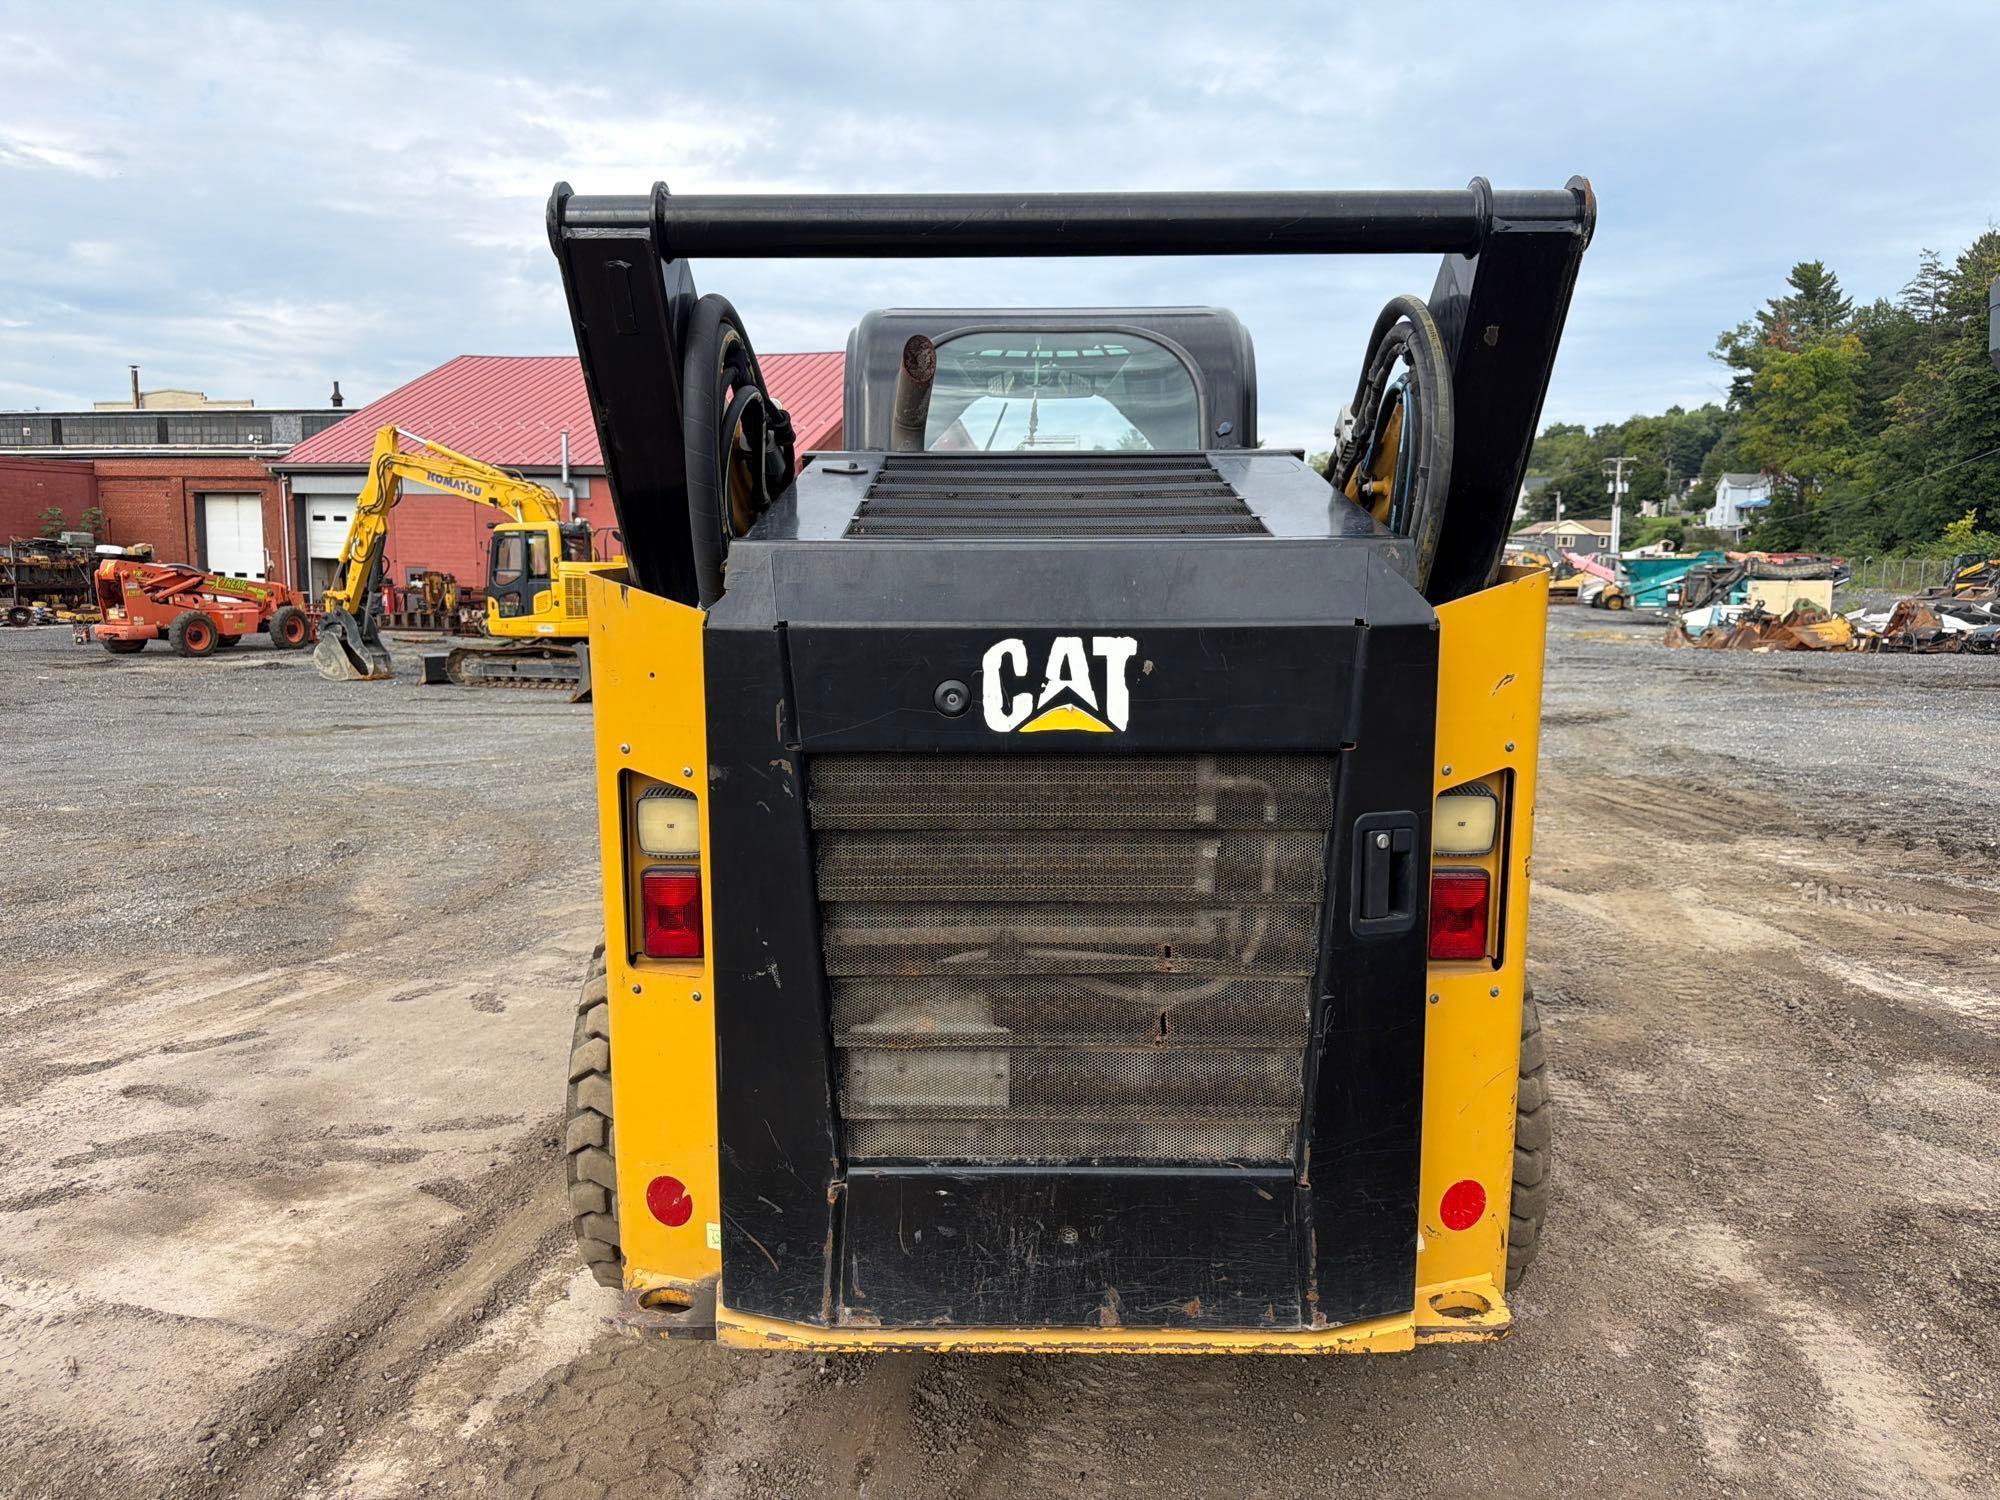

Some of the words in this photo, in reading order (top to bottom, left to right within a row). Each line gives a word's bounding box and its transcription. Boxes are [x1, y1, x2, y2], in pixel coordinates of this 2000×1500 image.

[427, 471, 482, 496] KOMATSU
[210, 576, 248, 590] XTREME
[982, 636, 1138, 732] CAT
